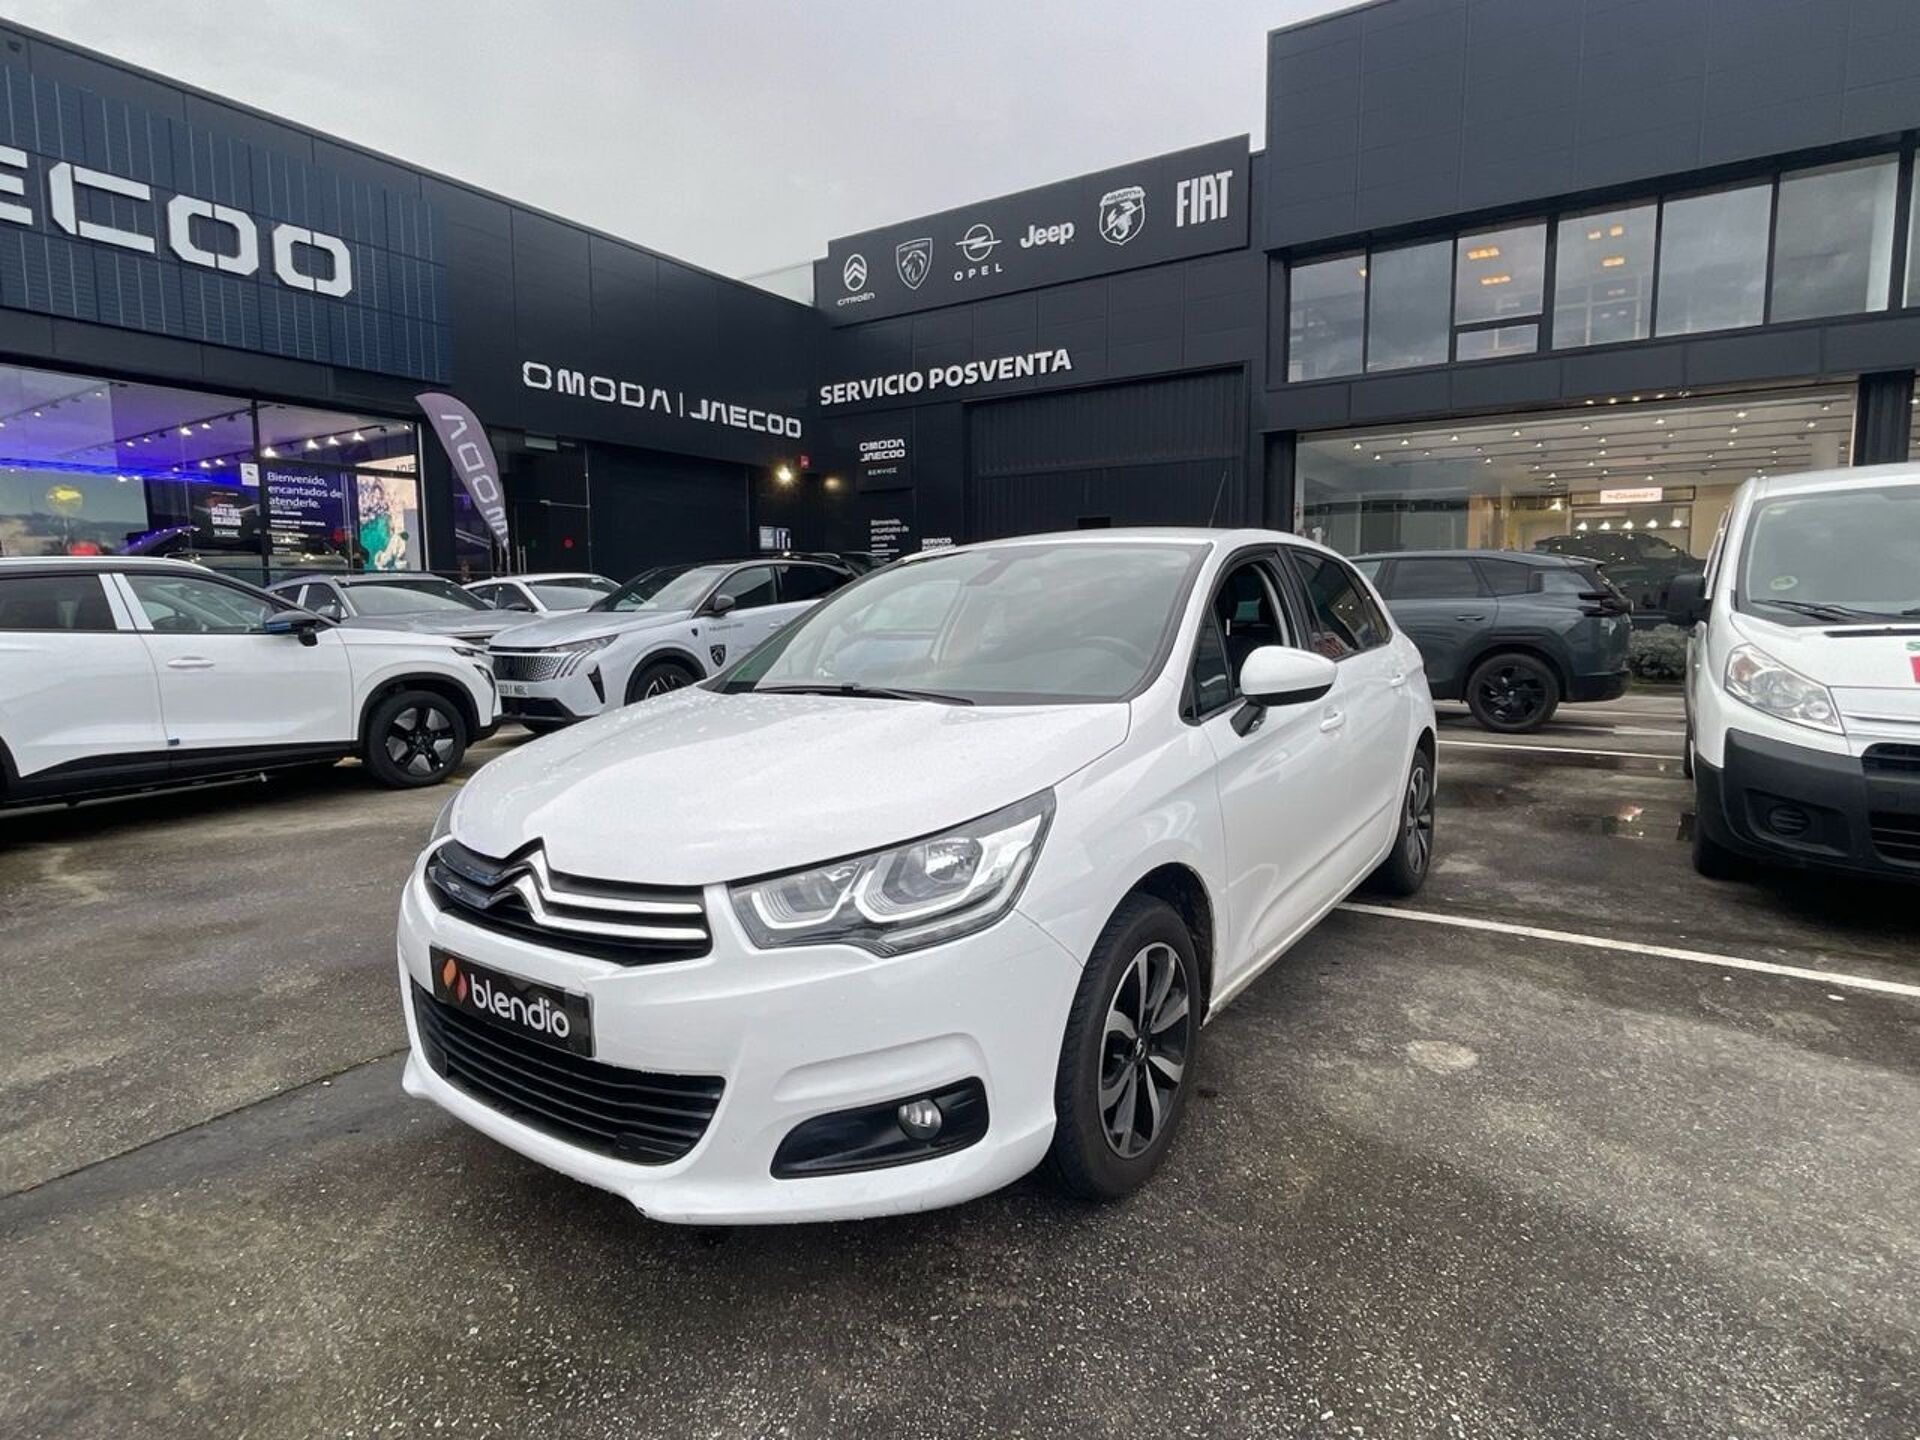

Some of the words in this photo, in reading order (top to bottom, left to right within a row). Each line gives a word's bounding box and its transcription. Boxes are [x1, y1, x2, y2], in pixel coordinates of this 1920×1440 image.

[1176, 169, 1233, 228] FIAT
[1020, 221, 1075, 250] Jeep
[954, 263, 1004, 282] OPEL
[819, 370, 924, 406] SERVICIO
[928, 348, 1072, 390] POSVENTA
[522, 360, 671, 415] OMODA
[690, 397, 803, 440] JAECOO
[860, 449, 906, 462] JAECOO
[267, 471, 328, 486] Bienvenido,
[268, 486, 328, 498] encantados
[329, 488, 344, 499] de
[269, 497, 321, 509] atenderle.
[471, 973, 571, 1039] blendio
